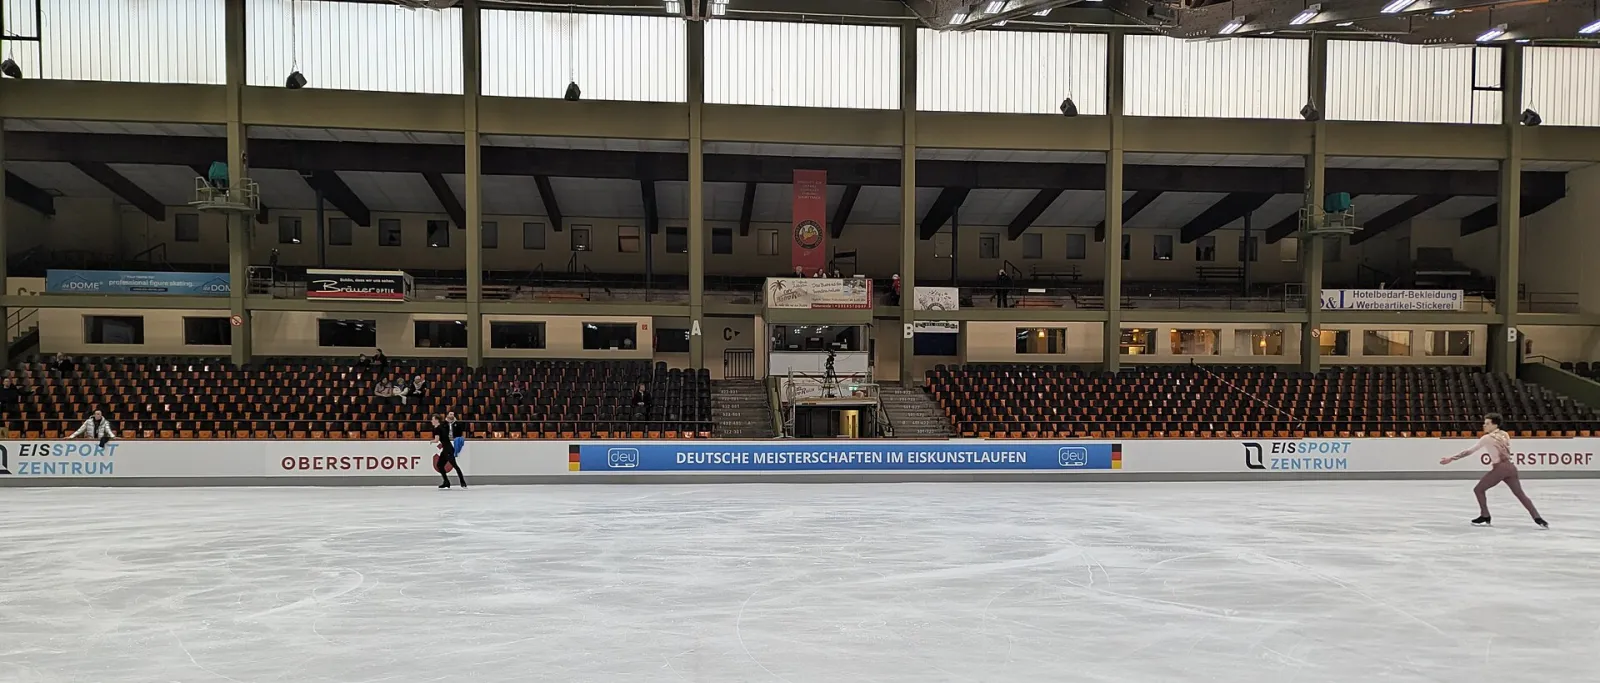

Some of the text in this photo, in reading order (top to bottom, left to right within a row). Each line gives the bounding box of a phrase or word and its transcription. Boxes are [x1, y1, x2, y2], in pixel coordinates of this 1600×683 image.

[312, 279, 376, 293] Bräuer
[1353, 290, 1457, 300] Hotelbedarf-Bekleidung
[1356, 301, 1454, 310] Werbeartikel-Stickerei
[691, 320, 702, 335] A
[723, 327, 733, 341] C
[904, 323, 914, 339] B
[1507, 327, 1517, 342] B
[1271, 442, 1351, 454] EISSPORT
[610, 450, 636, 462] deu
[676, 451, 1027, 465] DEUTSCHE MEISTERSCHAFTEN IM EISKUNSTLAUFEN
[1061, 449, 1085, 461] deu
[1480, 453, 1593, 466] ORSTDORF
[18, 462, 114, 475] ZENTRUM
[281, 456, 421, 470] OBERSTDORF
[1271, 458, 1347, 470] ZENTRUM
